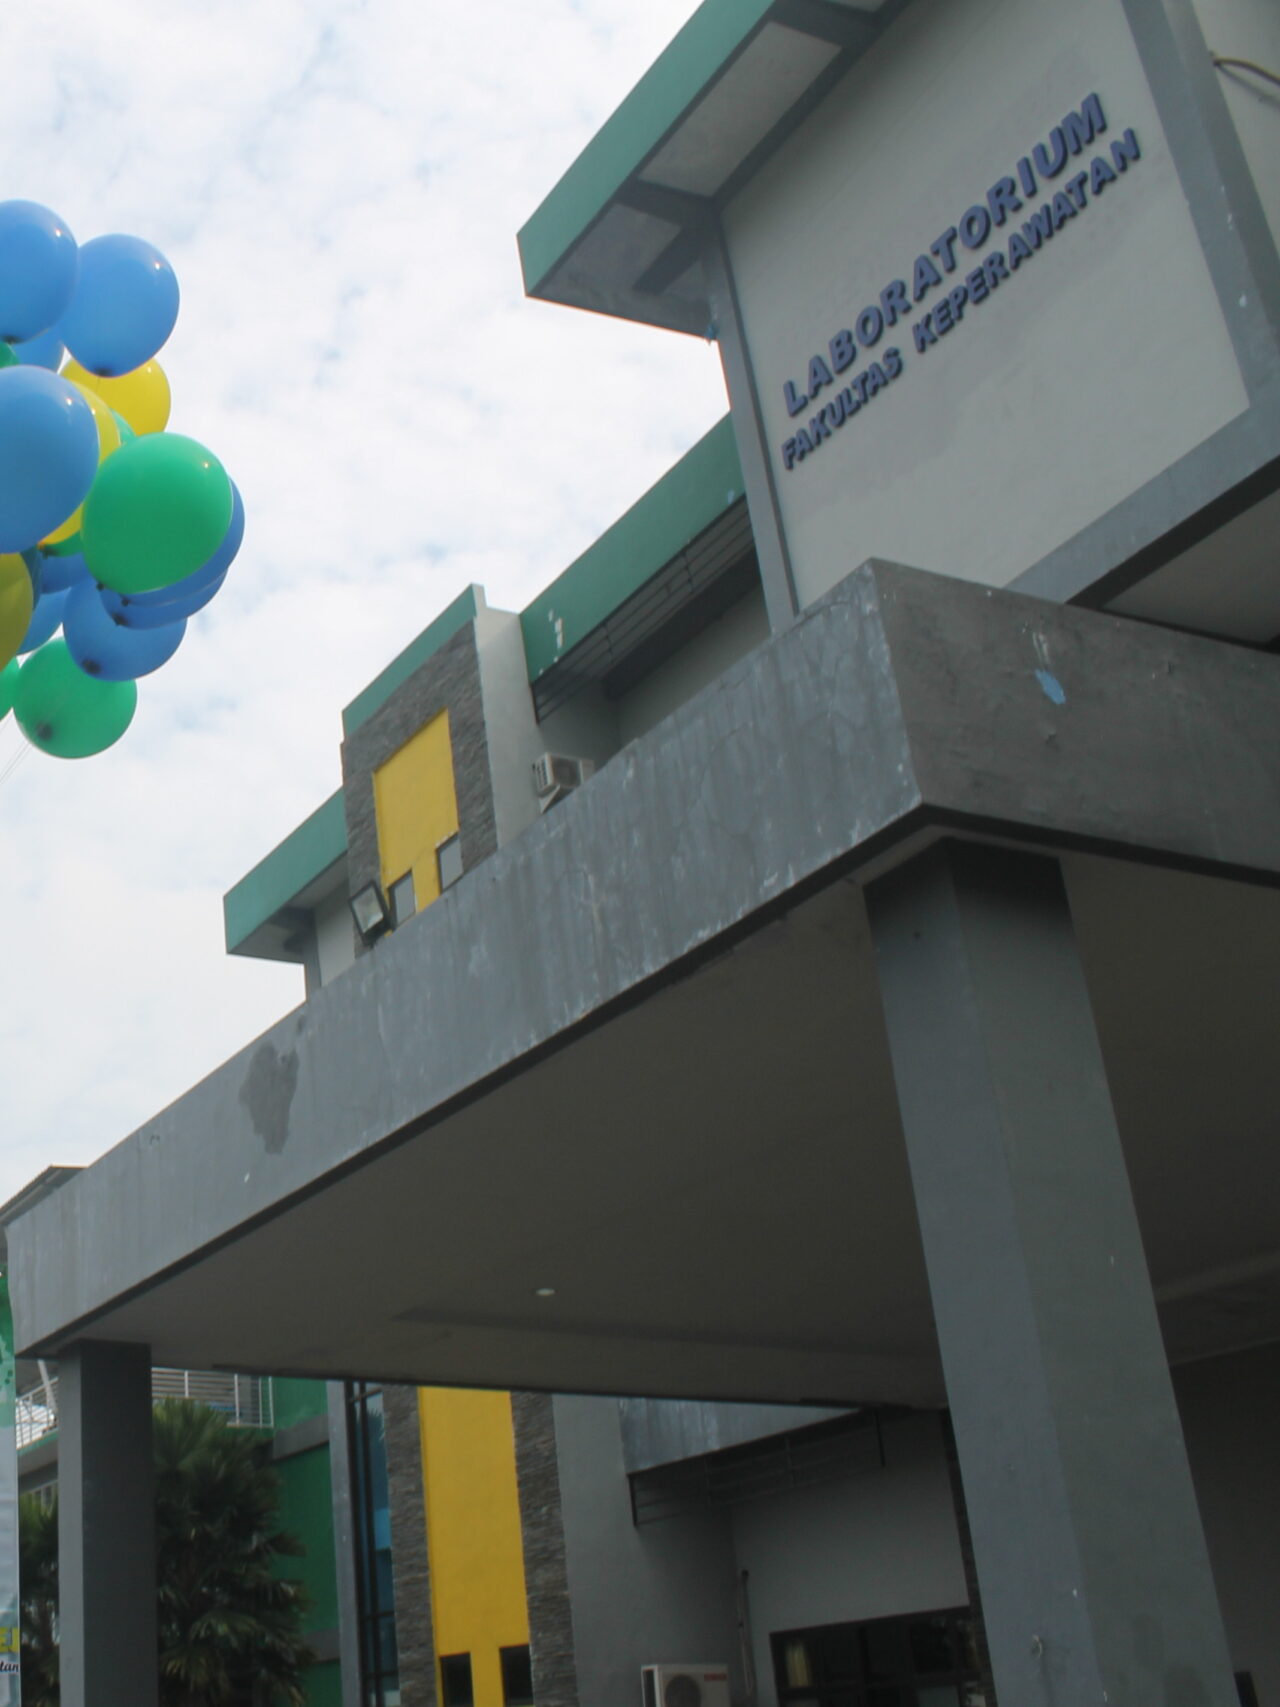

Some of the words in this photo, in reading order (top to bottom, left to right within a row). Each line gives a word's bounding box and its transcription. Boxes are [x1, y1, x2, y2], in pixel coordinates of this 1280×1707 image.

[781, 347, 903, 470] FAKULTAS
[912, 127, 1142, 353] KEPERAWATAN
[782, 92, 1108, 417] LABORATORIUM
